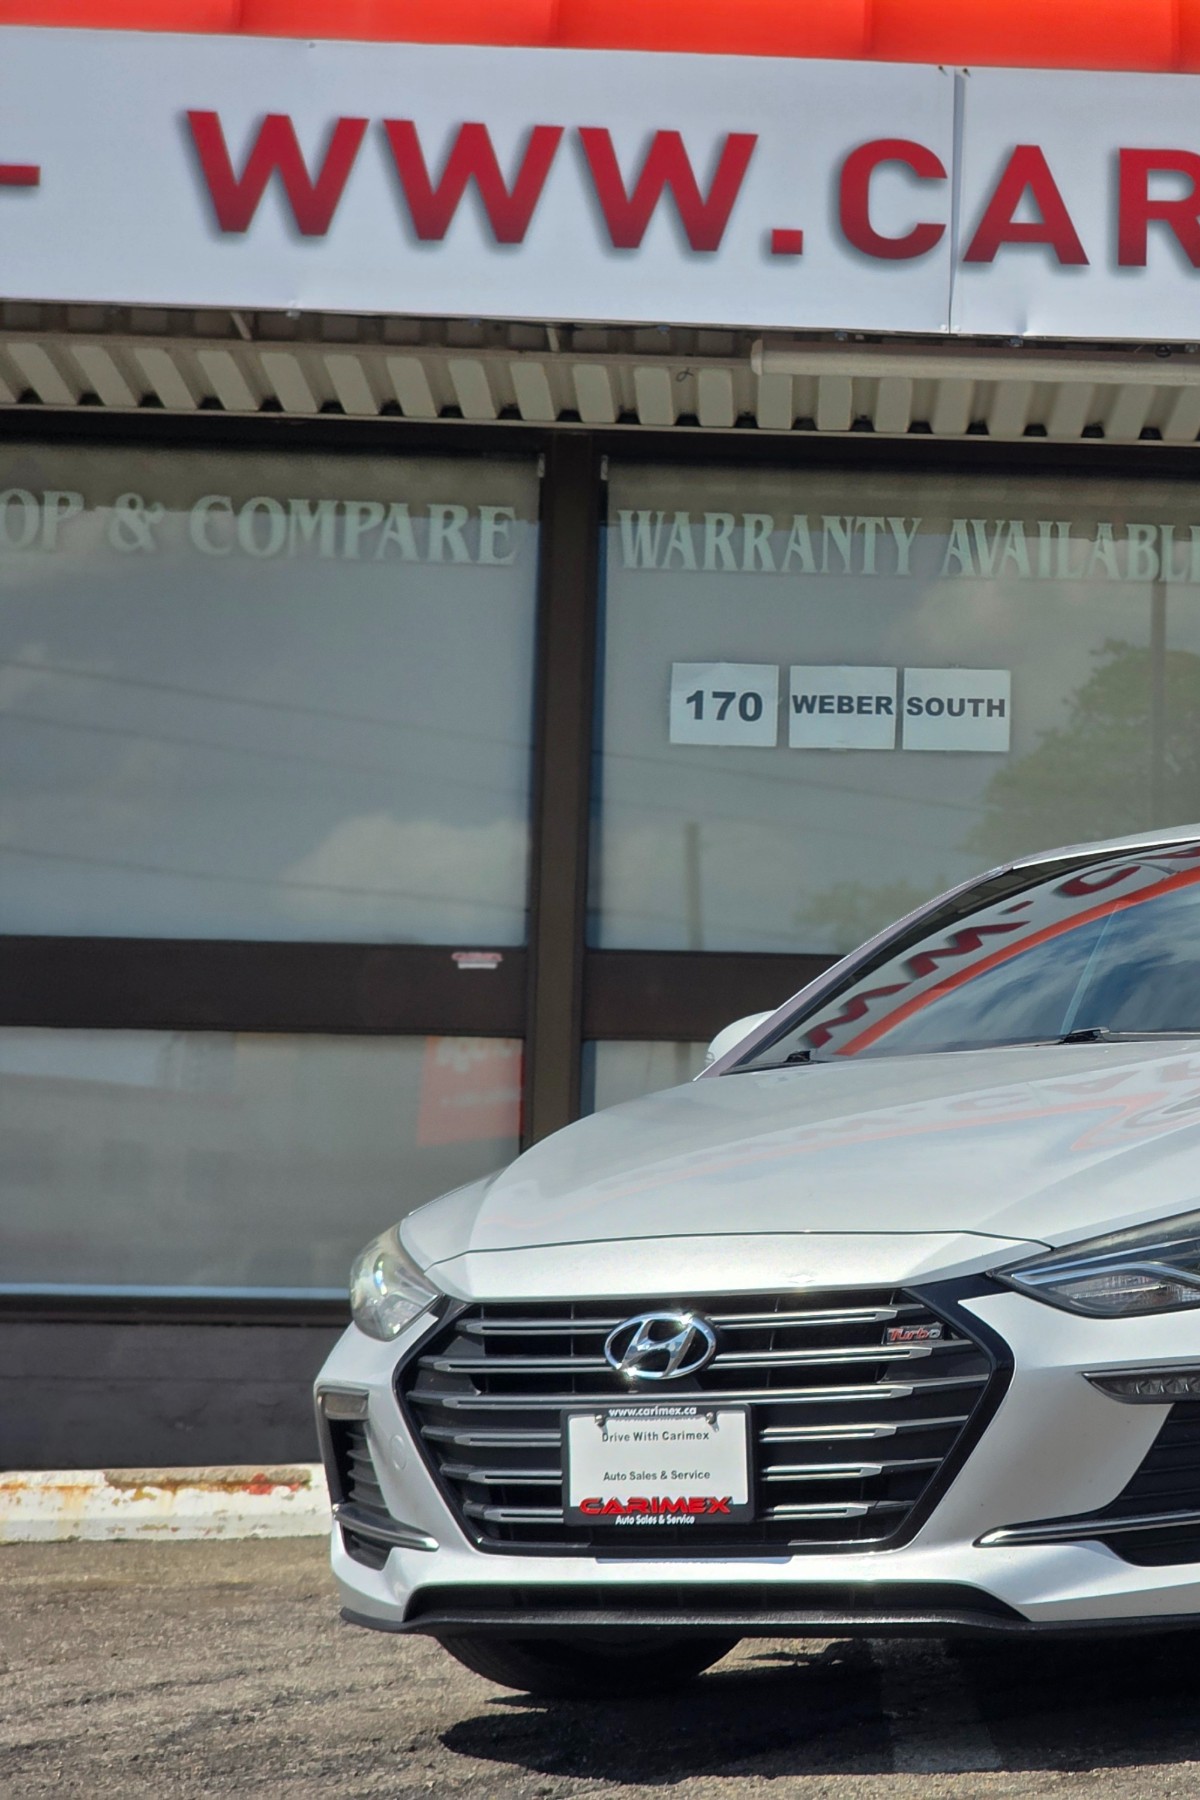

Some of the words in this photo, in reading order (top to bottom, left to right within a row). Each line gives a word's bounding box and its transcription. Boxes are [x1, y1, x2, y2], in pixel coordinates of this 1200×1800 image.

[108, 492, 164, 553] &
[190, 494, 517, 566] COMPARE
[618, 509, 922, 576] WARRANTY
[685, 690, 763, 722] 170
[791, 693, 895, 717] WEBER
[905, 696, 1006, 719] SOUTH
[889, 1328, 941, 1340] Turbo
[608, 1405, 697, 1417] www.carimex.ca
[601, 1432, 630, 1442] Drive
[633, 1431, 659, 1441] With
[662, 1430, 710, 1441] Carimex
[603, 1471, 627, 1481] Auto
[629, 1470, 657, 1481] Sales
[660, 1470, 668, 1480] &
[670, 1469, 711, 1480] Service
[579, 1496, 733, 1515] CARIMEX
[615, 1515, 634, 1525] Auto
[636, 1514, 657, 1525] Sales
[659, 1514, 665, 1524] &
[667, 1513, 695, 1524] Service
